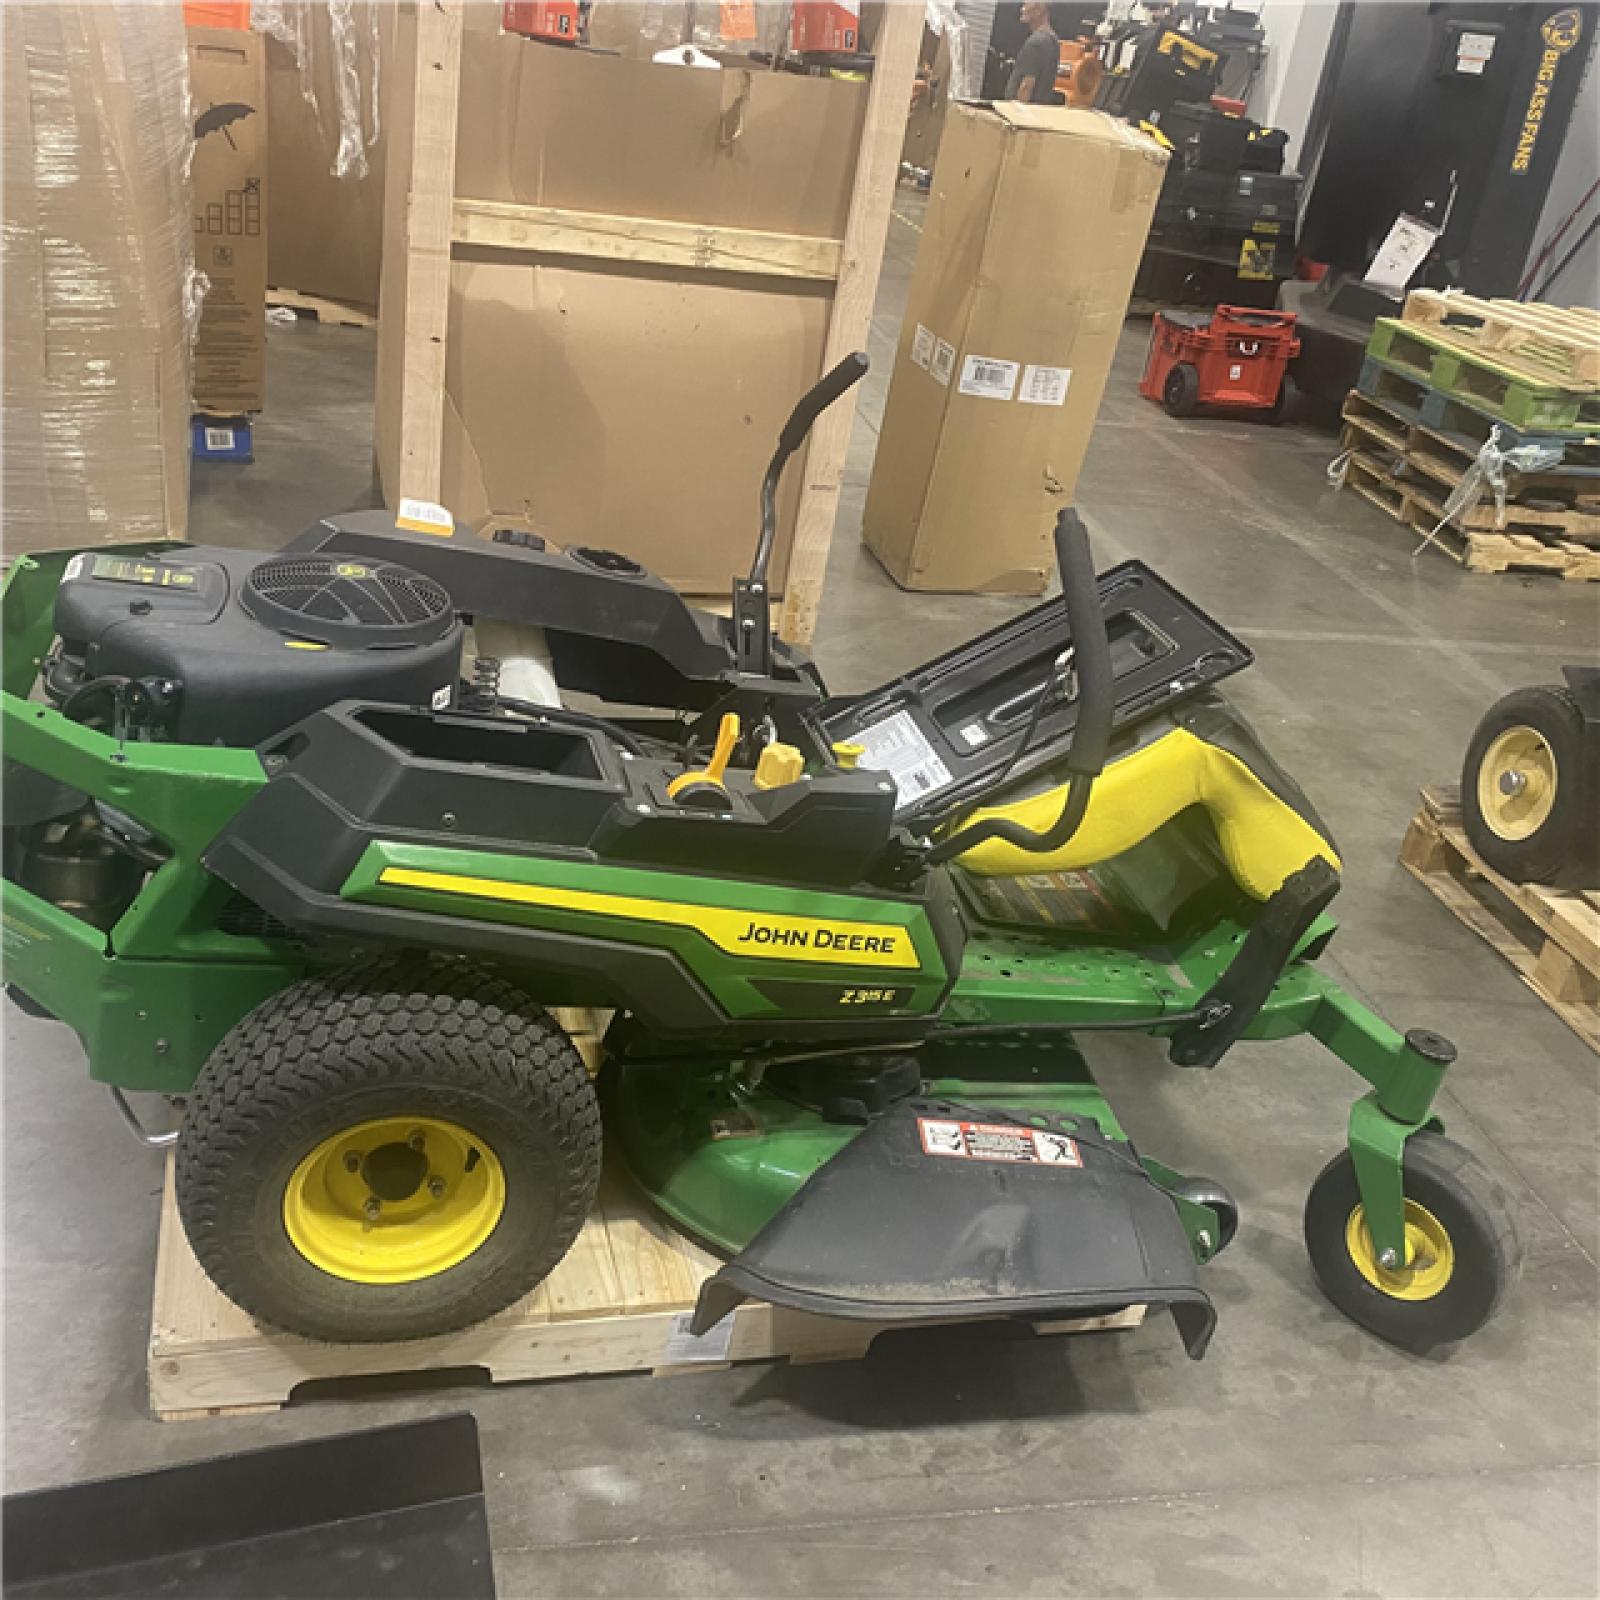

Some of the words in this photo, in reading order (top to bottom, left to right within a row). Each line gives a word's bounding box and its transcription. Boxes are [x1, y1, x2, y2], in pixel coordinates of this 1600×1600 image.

[1538, 50, 1560, 80] BIG
[1527, 82, 1549, 120] ASS
[1512, 122, 1539, 170] FANS
